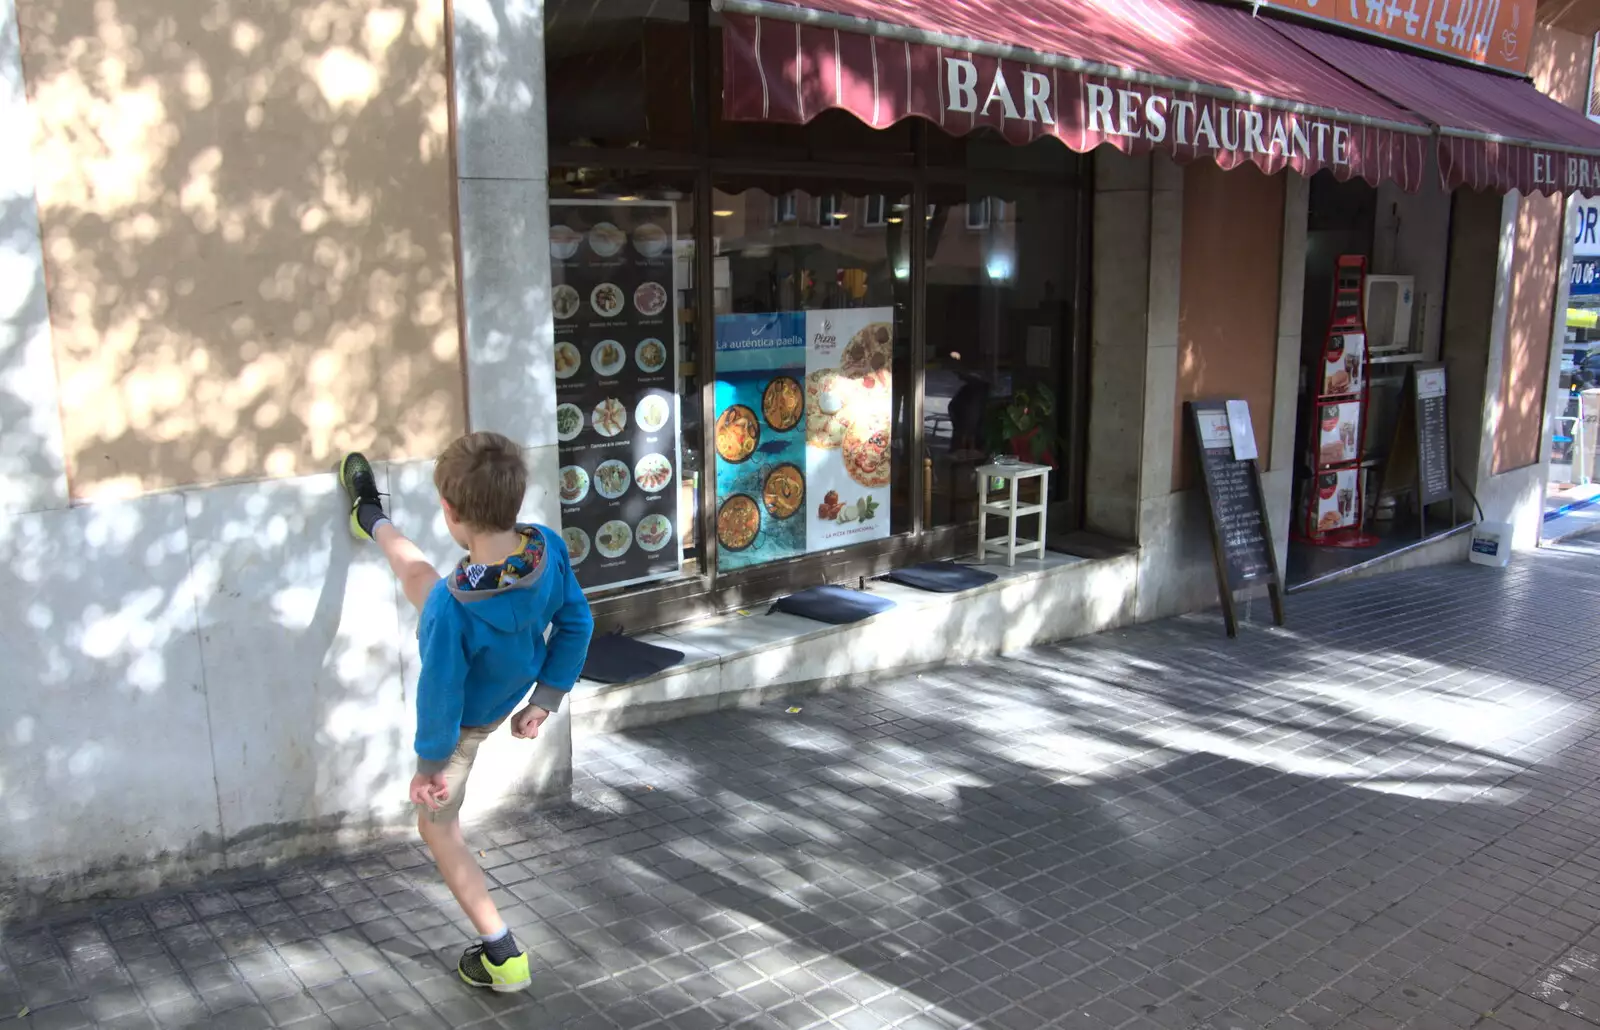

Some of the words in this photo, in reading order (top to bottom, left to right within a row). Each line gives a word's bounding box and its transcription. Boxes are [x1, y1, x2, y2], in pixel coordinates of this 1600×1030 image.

[946, 57, 1054, 125] BAR
[1087, 82, 1351, 166] RESTAURANTE
[1533, 153, 1555, 184] EL
[715, 340, 727, 349] La
[729, 337, 774, 349] auténtica
[776, 335, 803, 347] paella
[813, 332, 837, 345] Pizza
